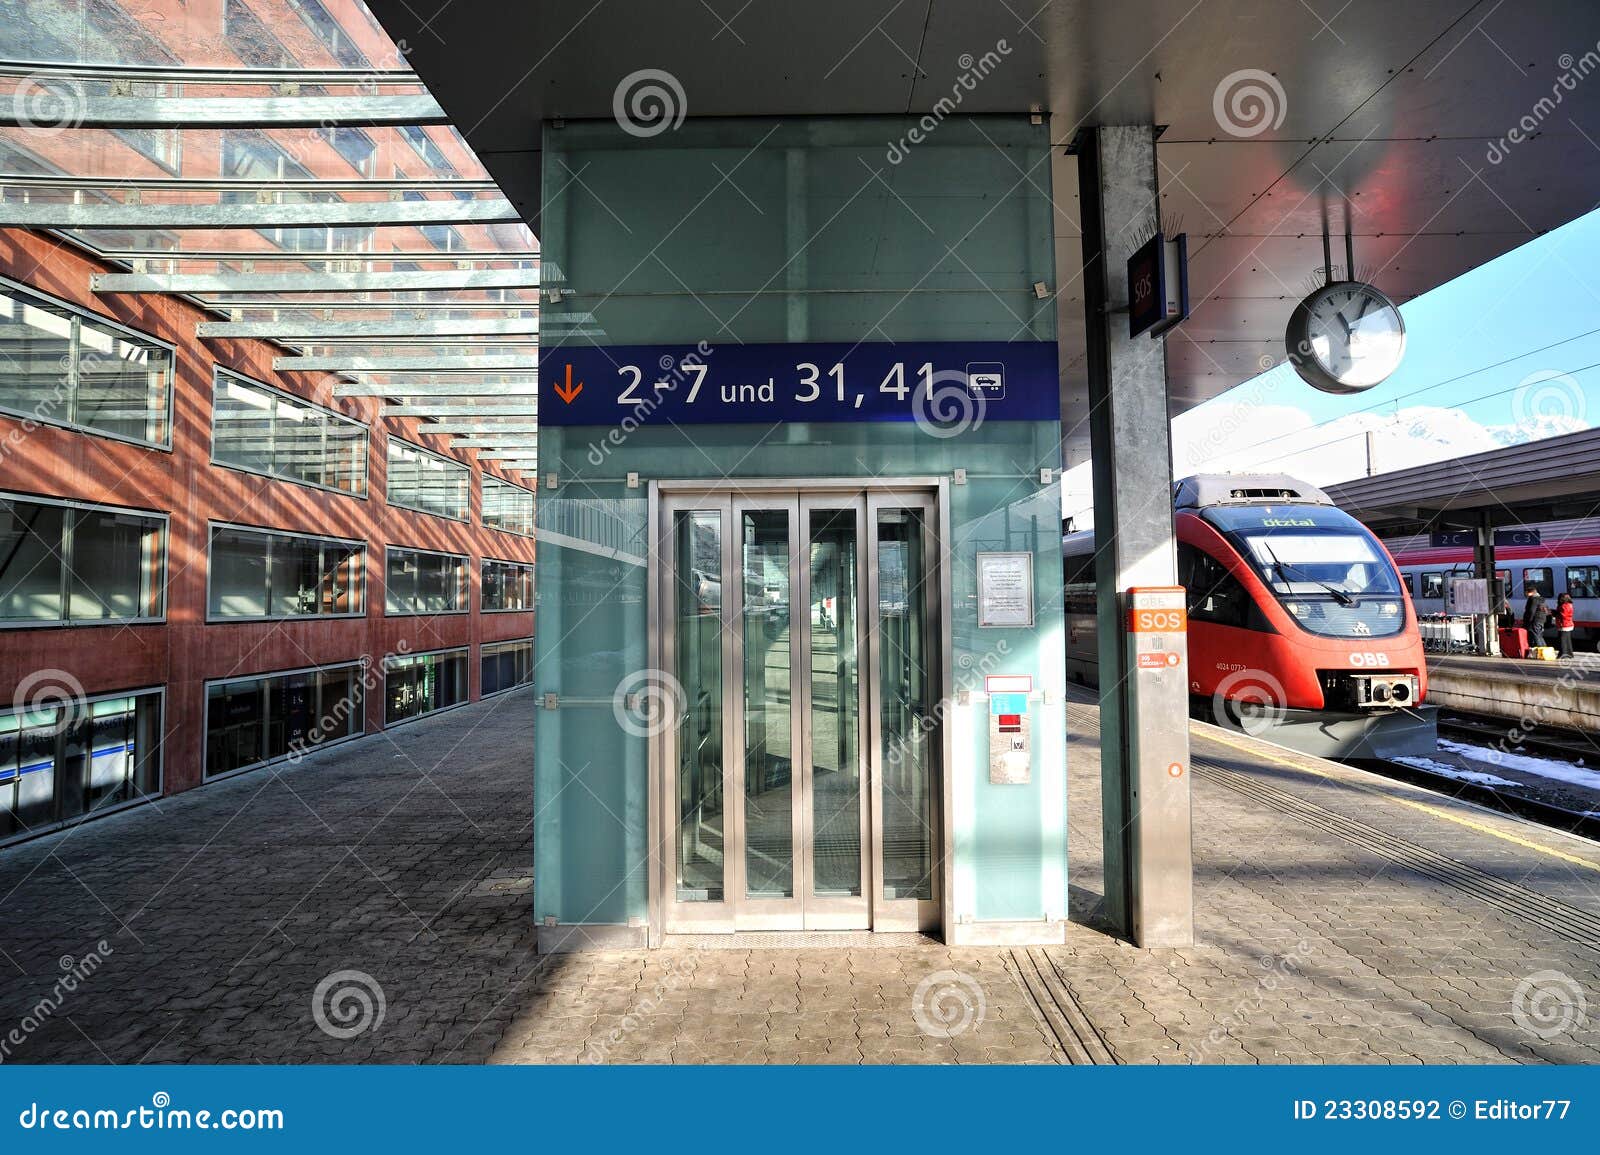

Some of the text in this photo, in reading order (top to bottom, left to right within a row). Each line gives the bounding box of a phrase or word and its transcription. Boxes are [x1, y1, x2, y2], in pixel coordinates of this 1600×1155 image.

[1135, 273, 1152, 303] SOS
[720, 378, 775, 403] und
[878, 361, 935, 402] 41
[1512, 534, 1533, 543] C 3
[1140, 612, 1181, 629] SOS
